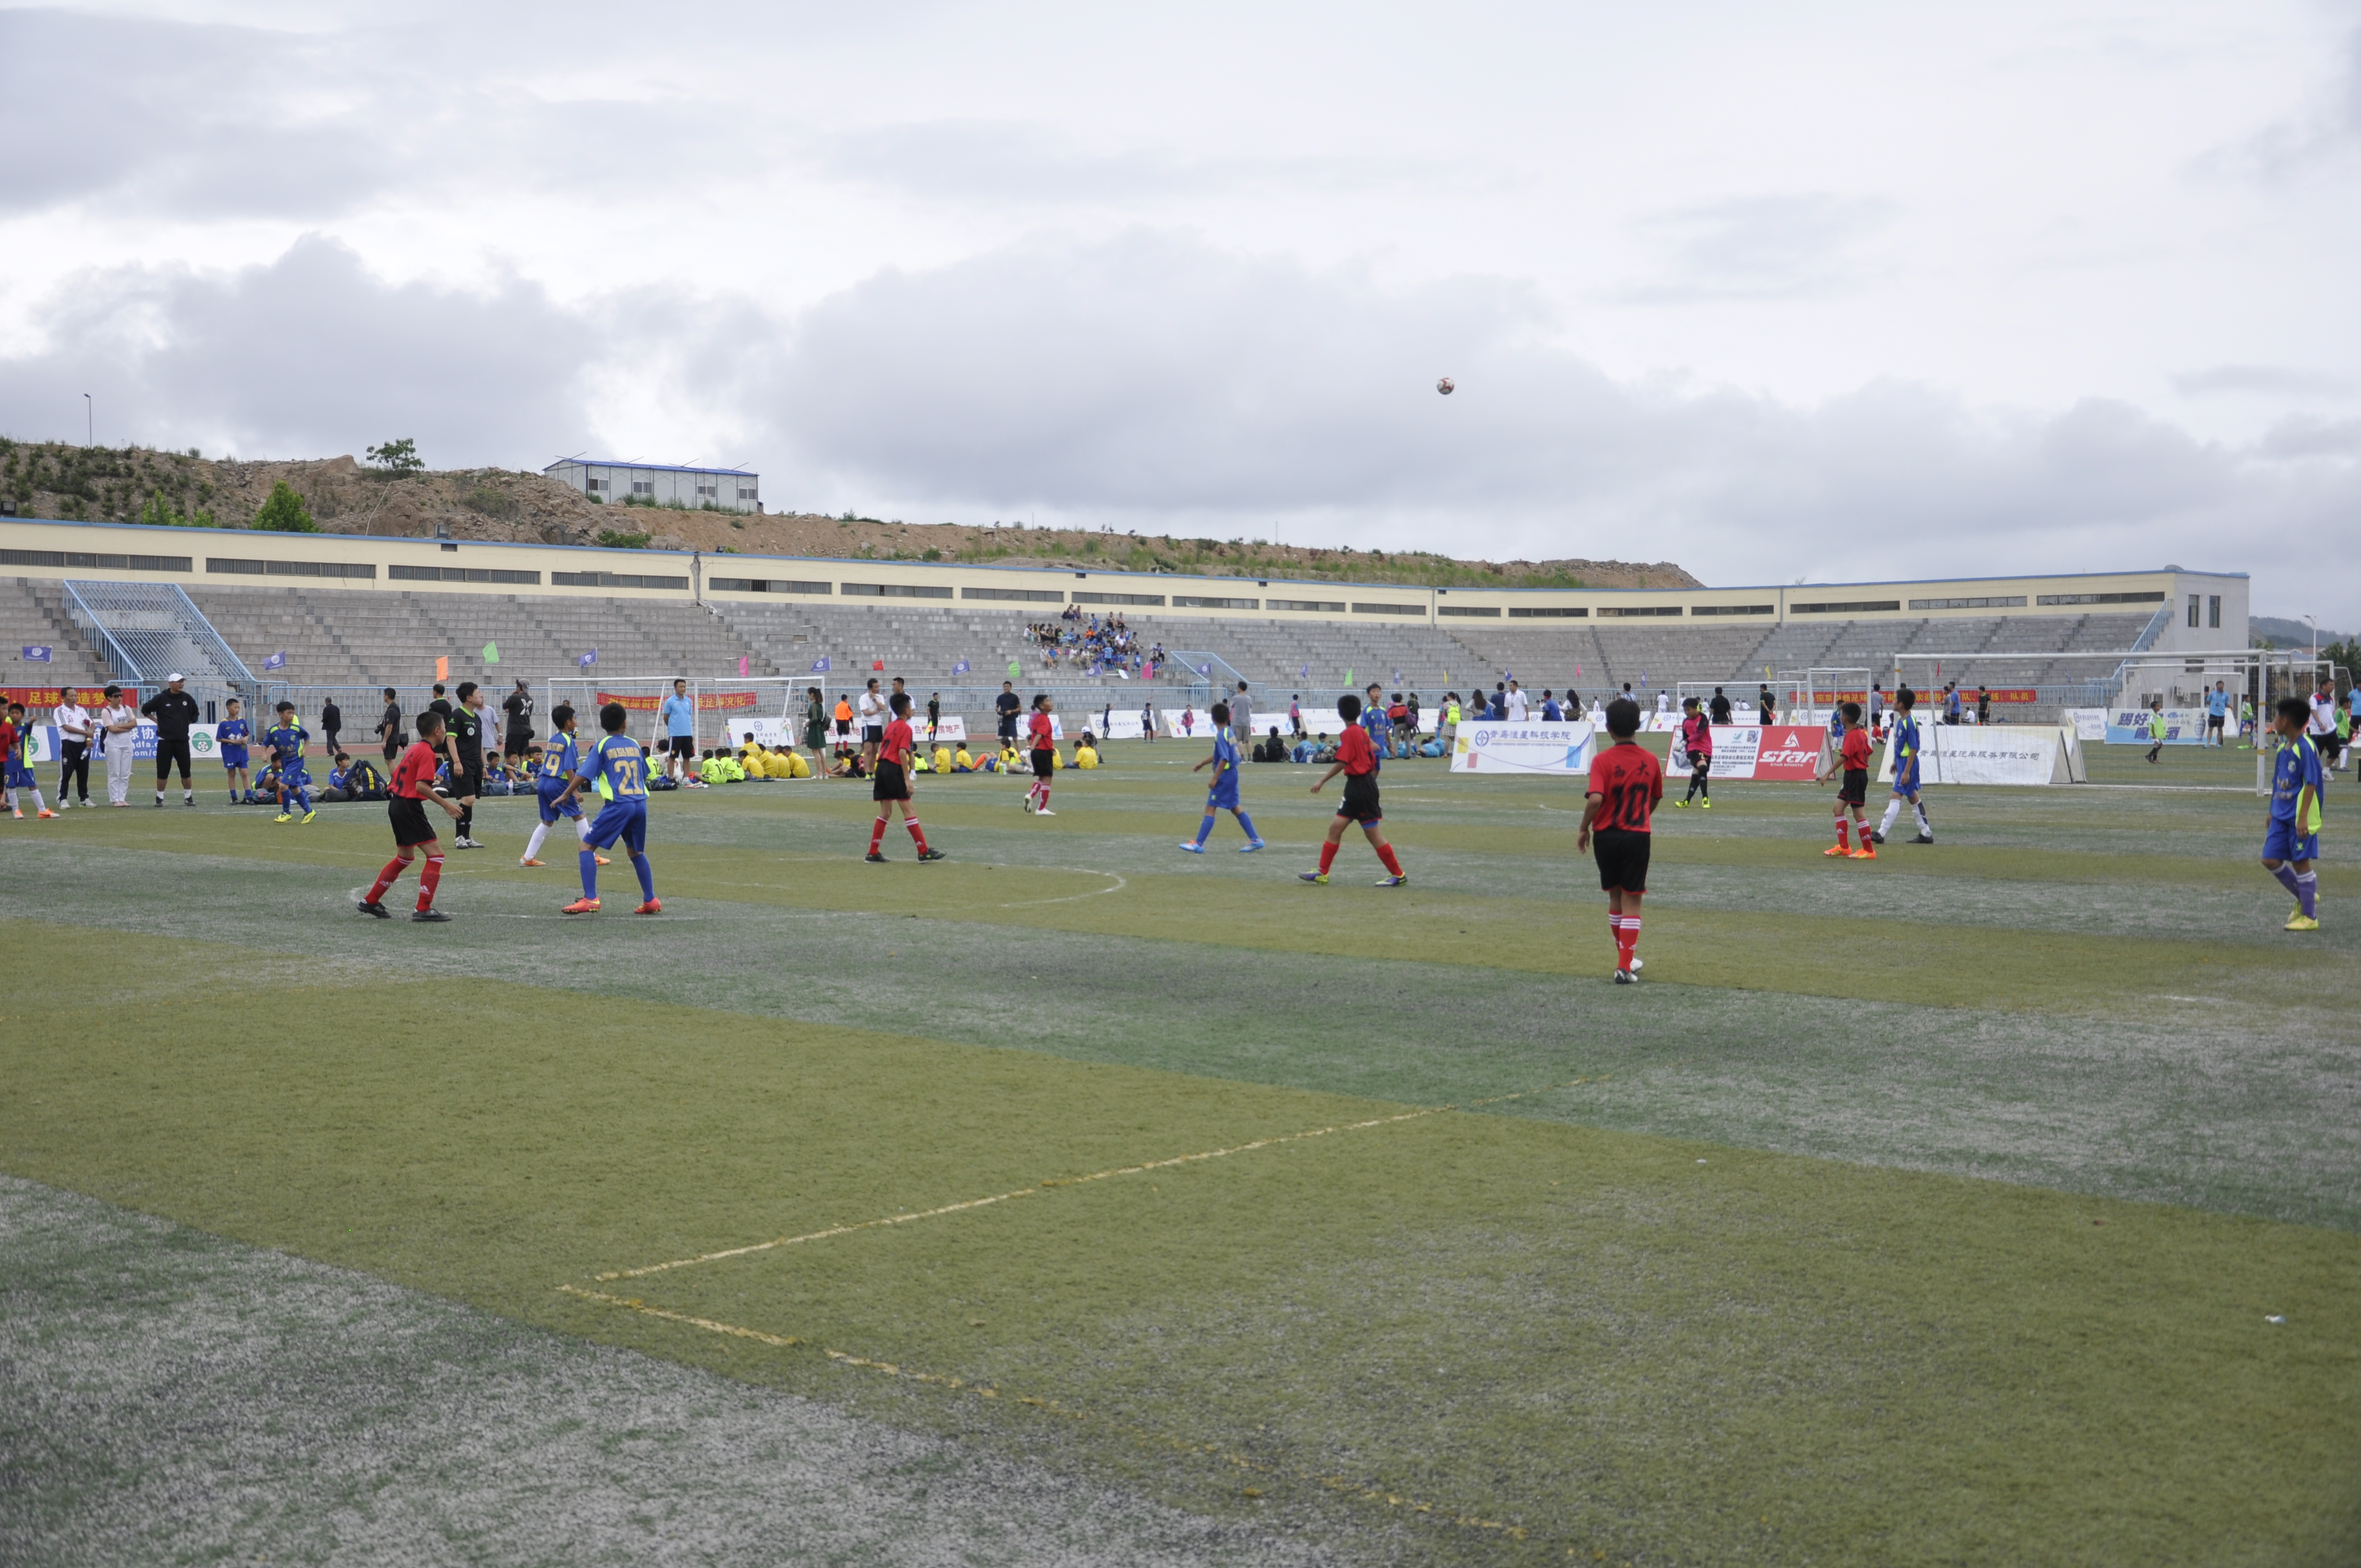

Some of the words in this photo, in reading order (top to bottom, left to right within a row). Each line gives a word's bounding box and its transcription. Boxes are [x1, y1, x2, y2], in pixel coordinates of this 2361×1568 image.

[2117, 712, 2163, 726] 踢好
[915, 725, 960, 734] 岛恒房地产
[1489, 730, 1571, 740] 青岛恒星科技学院
[2134, 727, 2181, 740] 喝酒
[614, 760, 644, 796] 21
[1612, 782, 1649, 825] 10
